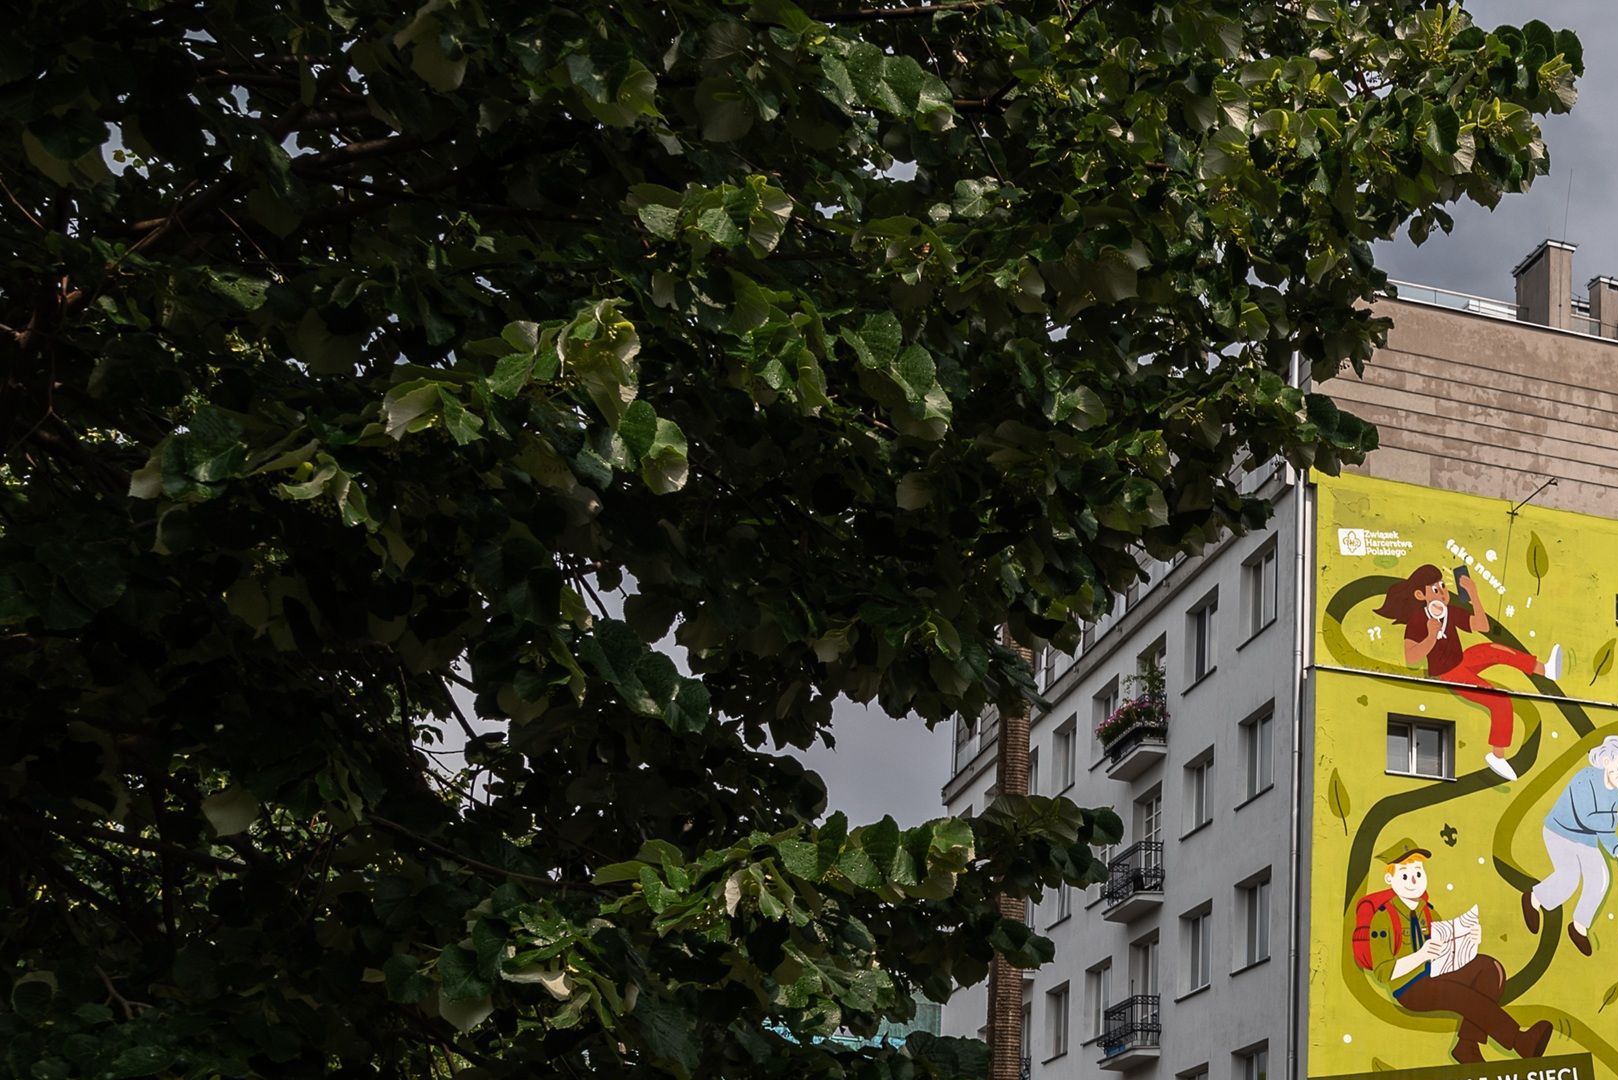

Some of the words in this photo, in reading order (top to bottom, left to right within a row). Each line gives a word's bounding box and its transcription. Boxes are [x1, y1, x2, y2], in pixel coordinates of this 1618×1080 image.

[1366, 547, 1407, 557] Polskiego
[1446, 538, 1474, 565] fake
[1474, 561, 1507, 595] news
